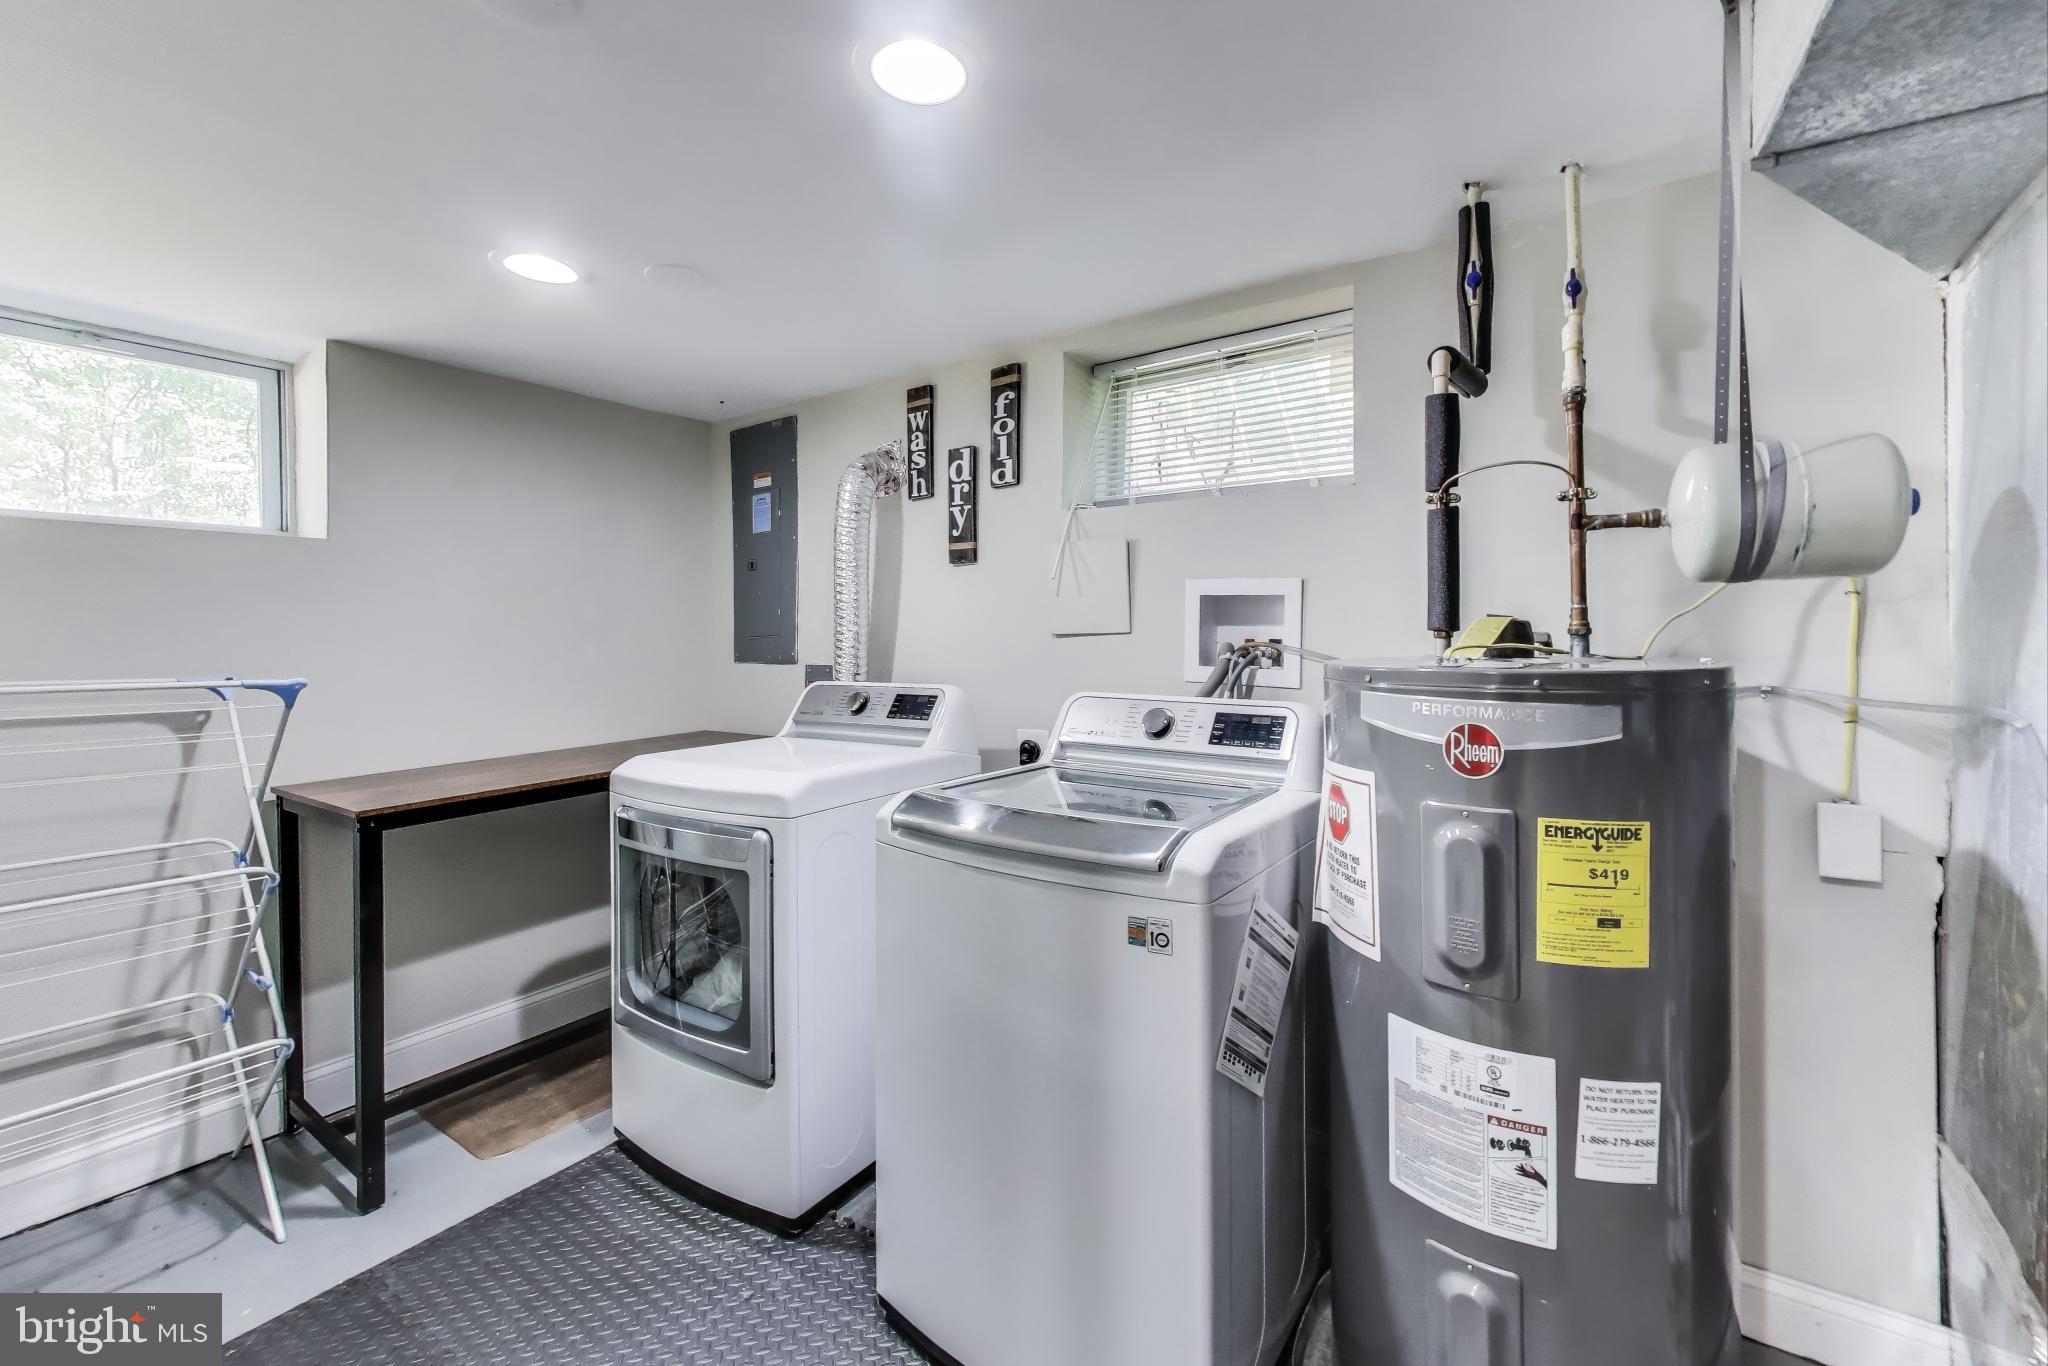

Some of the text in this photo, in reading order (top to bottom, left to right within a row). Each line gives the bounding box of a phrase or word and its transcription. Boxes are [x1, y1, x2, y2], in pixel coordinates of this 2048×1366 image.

[908, 411, 929, 497] wash
[992, 391, 1015, 484] fold
[949, 448, 972, 536] dry
[1412, 701, 1546, 722] PERFORMANCE
[1450, 724, 1499, 769] Rheem
[1544, 824, 1643, 842] ENERGYGUIDE
[1588, 868, 1630, 881] $419
[1501, 1120, 1544, 1135] DANGER
